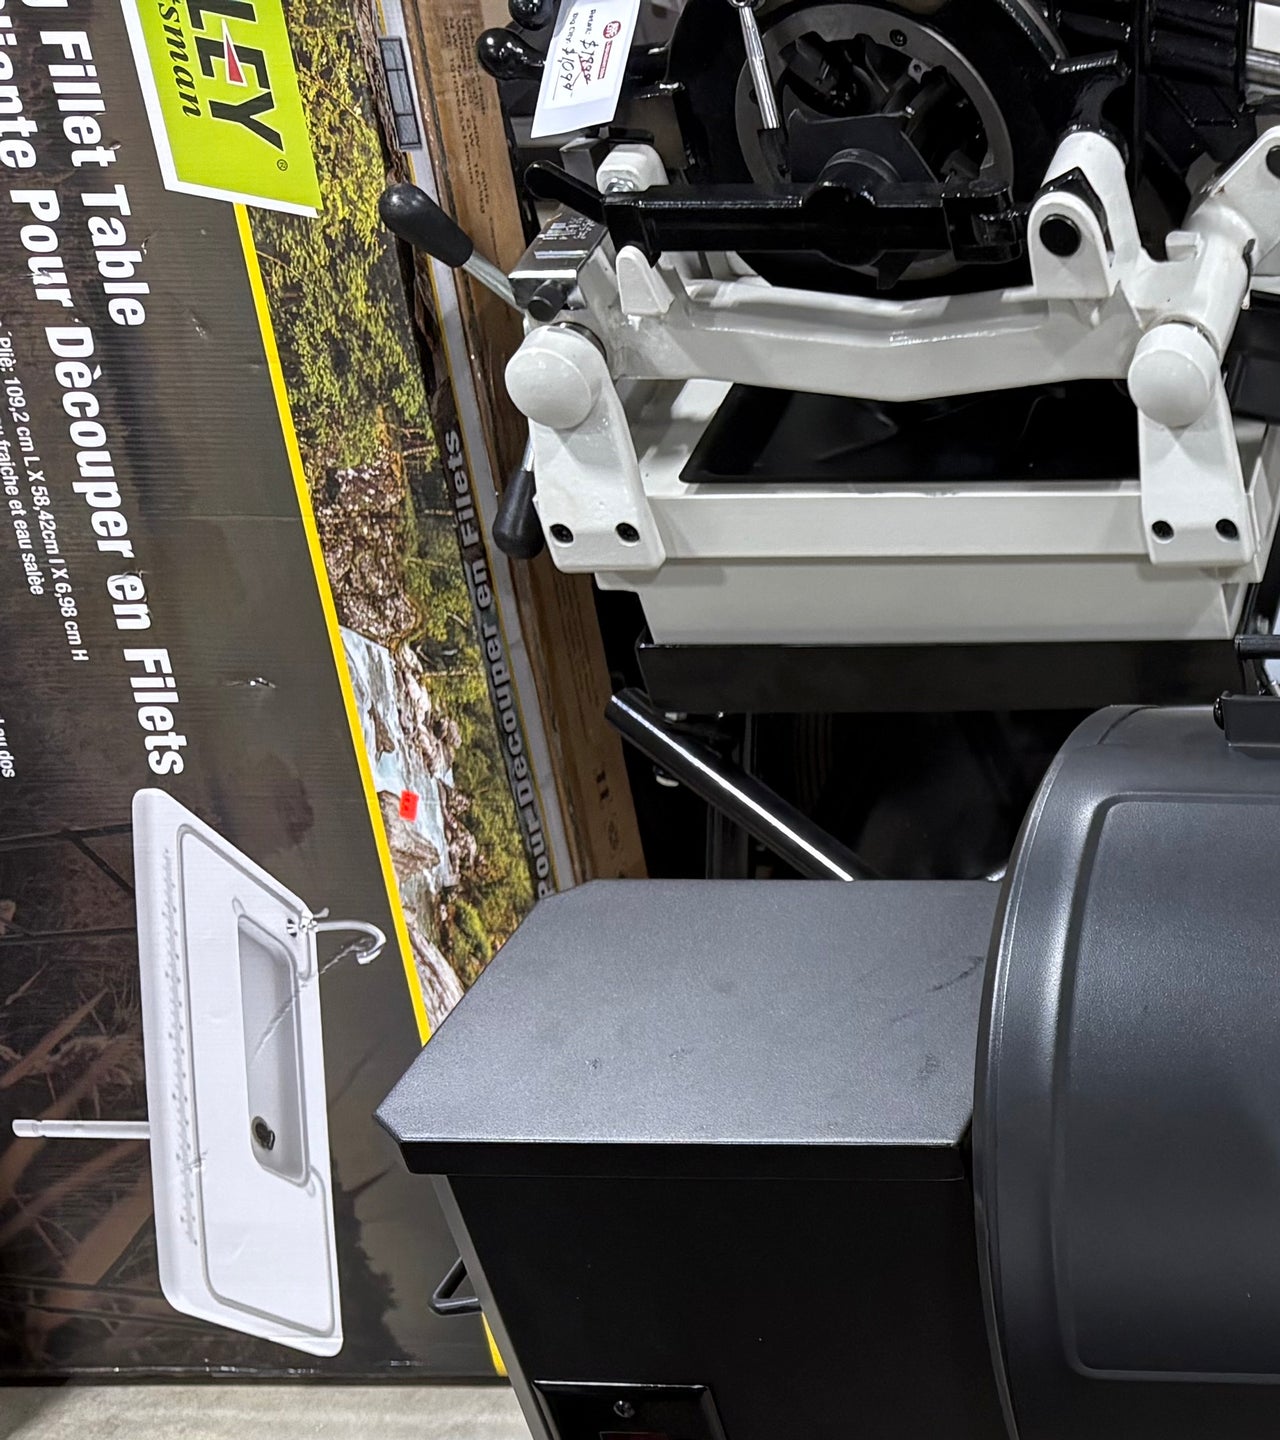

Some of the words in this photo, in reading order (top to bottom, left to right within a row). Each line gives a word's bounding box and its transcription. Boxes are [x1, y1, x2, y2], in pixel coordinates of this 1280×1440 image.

[158, 0, 202, 118] sman
[40, 31, 117, 168] Fillet
[80, 184, 146, 327] Table
[9, 189, 73, 307] Pour
[4, 377, 30, 423] 109,2
[16, 427, 34, 452] cm
[23, 457, 40, 467] L
[45, 326, 134, 558] Dècouper
[26, 470, 45, 482] X
[444, 430, 479, 548] Filets
[8, 500, 27, 516] et
[29, 485, 59, 555] 58,42cm
[14, 519, 32, 549] eau
[51, 568, 69, 580] X
[470, 557, 492, 610] en
[54, 582, 78, 618] 6,98
[106, 571, 152, 631] en
[64, 621, 82, 646] cm
[71, 649, 89, 661] H
[123, 647, 187, 776] Filets
